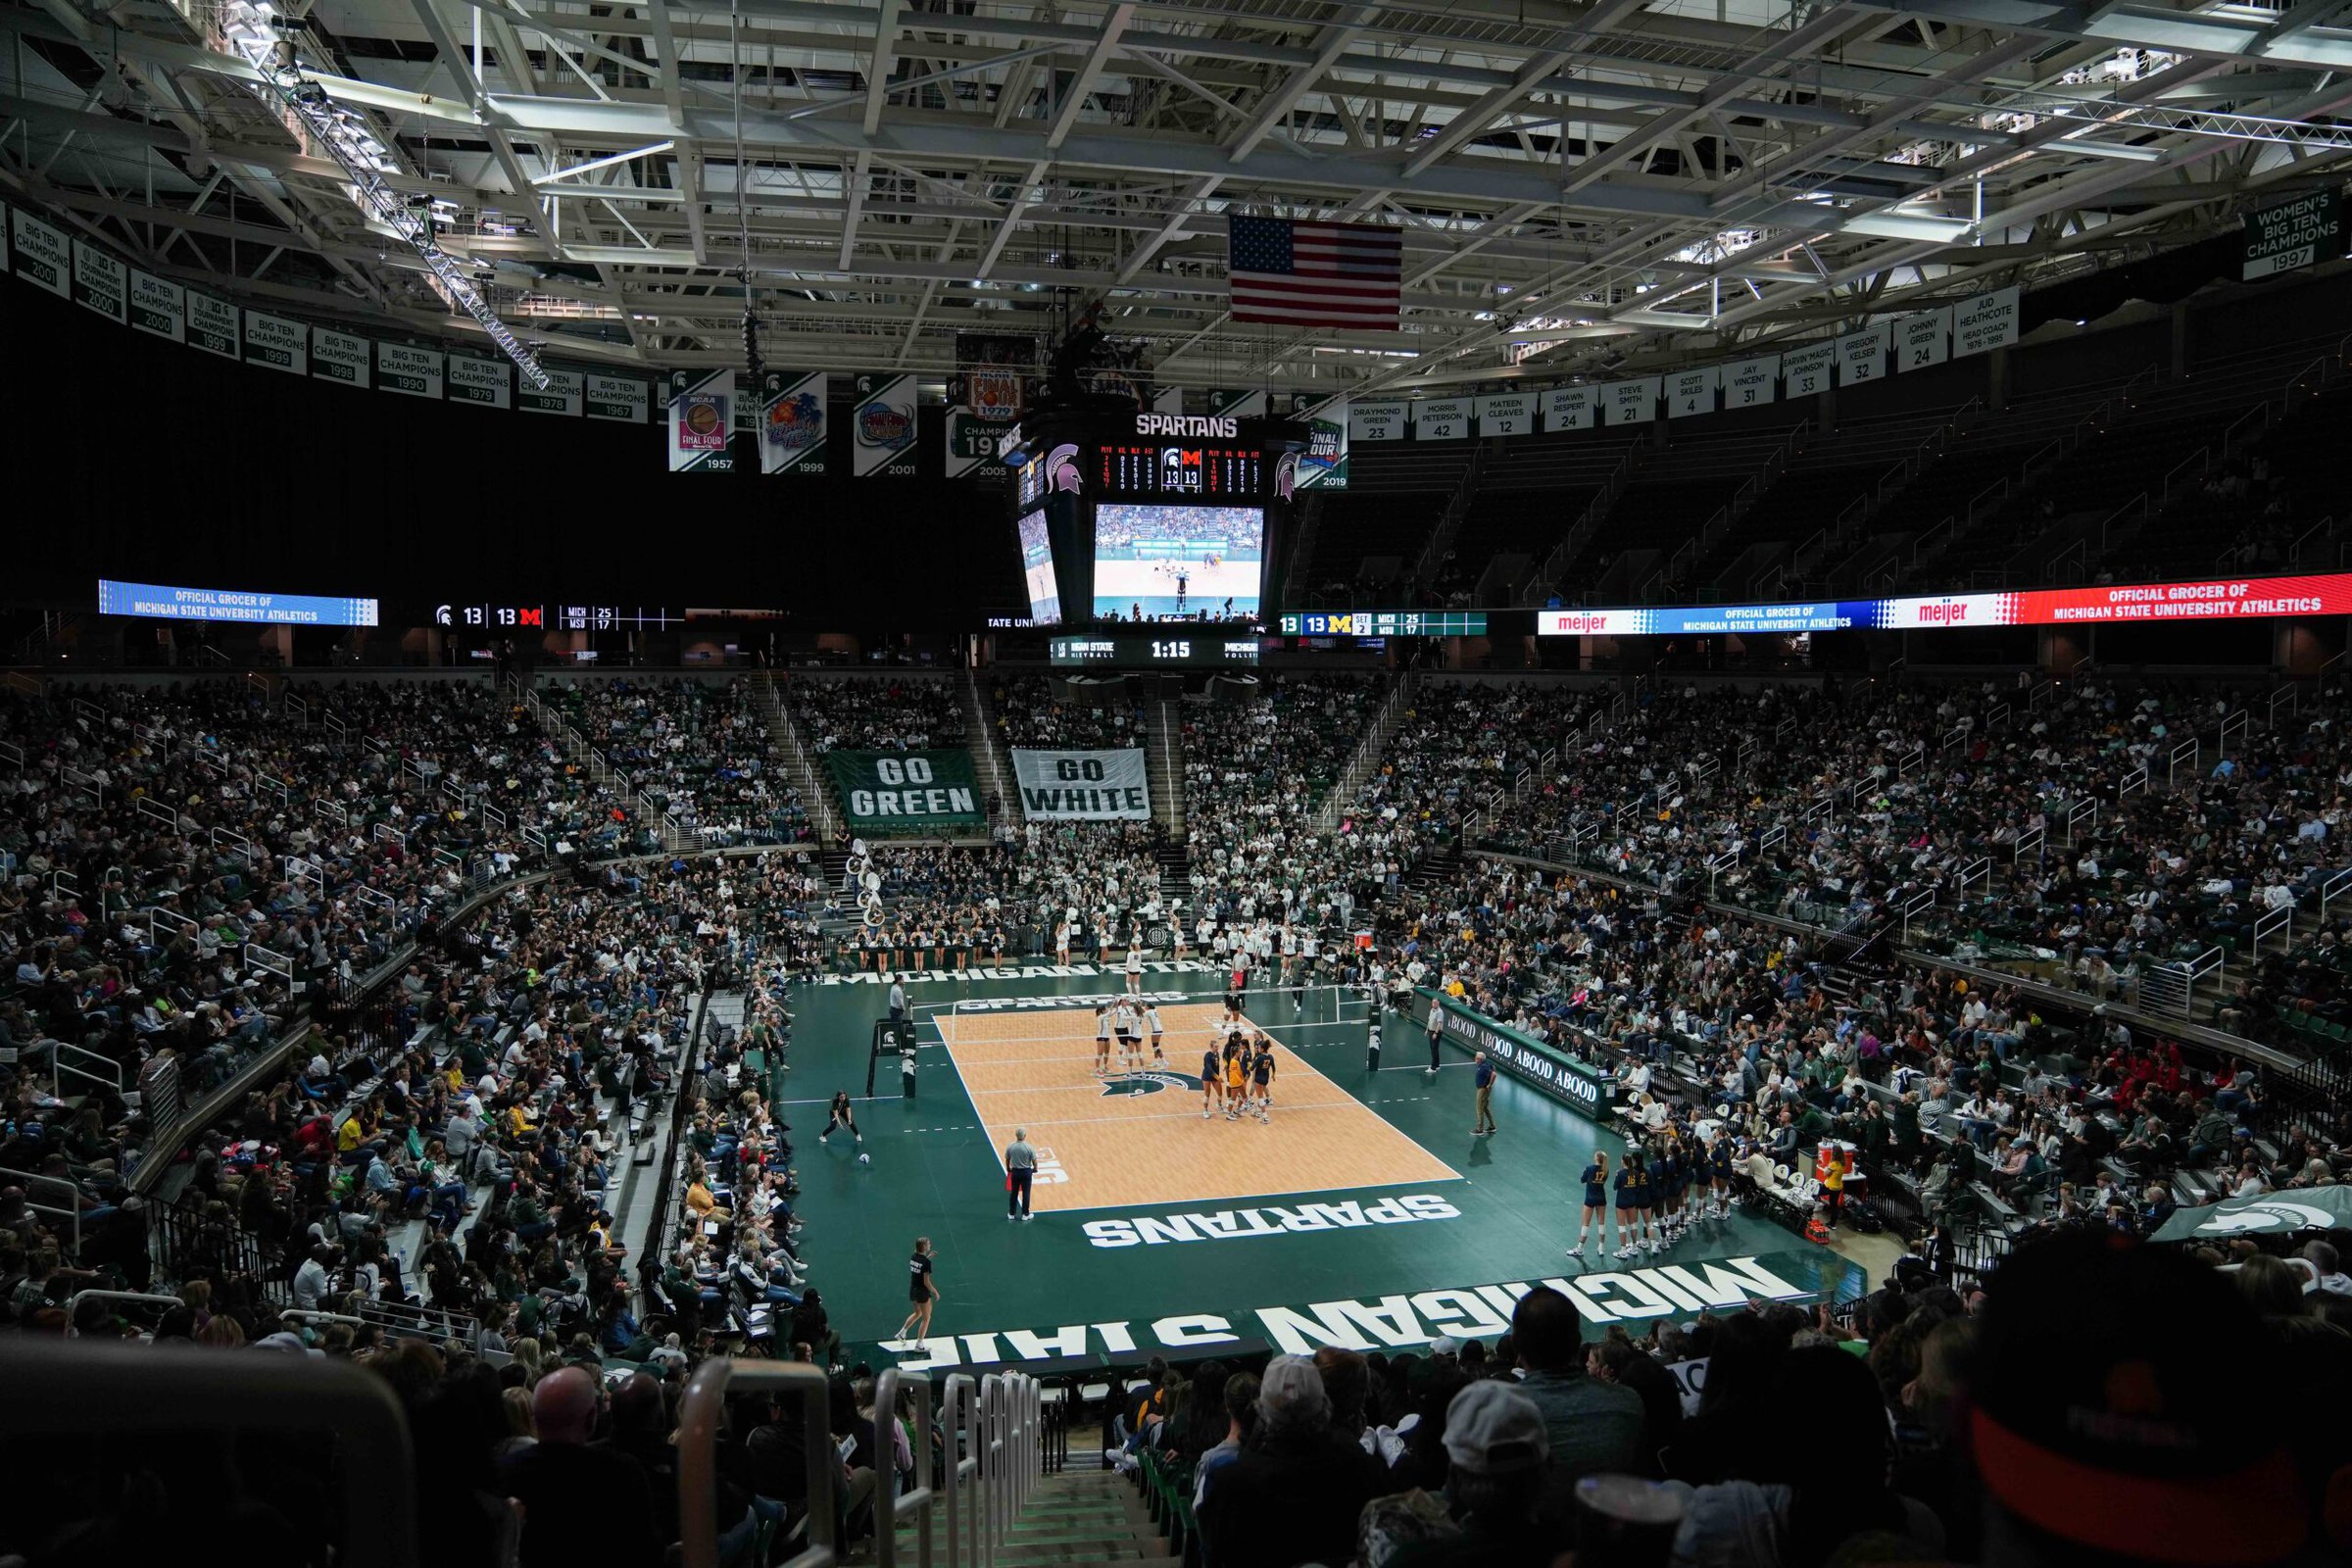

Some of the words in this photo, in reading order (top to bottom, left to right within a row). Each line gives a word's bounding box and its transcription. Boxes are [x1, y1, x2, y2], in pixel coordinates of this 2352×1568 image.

[2257, 193, 2328, 226] WOMEN'S
[2264, 221, 2288, 240] BIG
[2292, 212, 2322, 231] TEN
[25, 222, 40, 238] BIG
[41, 230, 59, 249] TEN
[2247, 220, 2338, 258] CHAMPIONS
[16, 233, 69, 269] CHAMPIONS
[2272, 248, 2310, 270] 1997
[32, 262, 56, 284] 2001
[80, 260, 121, 286] TOURNAMENT
[80, 271, 122, 298] CHAMPIONS
[142, 278, 157, 293] BIG
[157, 284, 173, 299] TEN
[88, 290, 114, 314] 2000
[133, 290, 183, 316] CHAMPIONS
[1978, 297, 1994, 311] JUD
[145, 313, 171, 331] 2000
[194, 308, 234, 326] TOURNAMENT
[1960, 305, 2012, 327] HEATHCOTE
[194, 318, 235, 337] CHAMPIONS
[259, 319, 274, 331] BIG
[276, 323, 294, 337] TEN
[1907, 318, 1938, 334] JOHNNY
[1962, 329, 1983, 341] HEAD
[1983, 321, 2009, 337] COACH
[204, 333, 225, 352] 1999
[247, 329, 306, 351] CHAMPIONS
[324, 335, 339, 347] BIG
[341, 339, 358, 351] TEN
[1845, 334, 1880, 351] GREGORY
[1910, 331, 1936, 346] GREEN
[1987, 333, 2004, 345] 1995
[266, 349, 290, 364] 1999
[314, 345, 368, 365] CHAMPIONS
[392, 349, 408, 361] BIG
[411, 353, 429, 364] TEN
[1849, 347, 1876, 362] KELSER
[1914, 347, 1931, 365] 24
[330, 364, 354, 379] 1998
[380, 360, 441, 376] CHAMPIONS
[463, 361, 478, 372] BIG
[480, 365, 498, 374] TEN
[1742, 366, 1758, 375] JAY
[1793, 362, 1825, 376] JOHNSON
[1855, 364, 1869, 379] 32
[397, 376, 424, 391] 1990
[451, 370, 509, 387] CHAMPIONS
[552, 374, 569, 384] TEN
[600, 380, 615, 390] BIG
[618, 382, 635, 392] TEN
[974, 378, 1017, 392] FINAL
[1680, 375, 1703, 386] SCOTT
[1735, 374, 1766, 386] VINCENT
[1801, 376, 1815, 392] 33
[468, 387, 493, 400] 1979
[589, 390, 647, 404] CHAMPIONS
[1555, 393, 1584, 402] SHAWN
[1618, 385, 1642, 395] STEVE
[1680, 385, 1703, 396] SKILES
[1744, 390, 1755, 403] 31
[539, 396, 564, 410] 1978
[1490, 399, 1522, 409] MATEEN
[1619, 394, 1642, 405] SMITH
[1688, 400, 1695, 412] 4
[606, 405, 630, 416] 1967
[1353, 408, 1400, 416] DRAYMOND
[1488, 408, 1524, 417] CLEAVES
[1553, 402, 1586, 413] RESPERT
[1624, 408, 1637, 420] 21
[1423, 413, 1462, 422] PETERSON
[1561, 416, 1576, 427] 24
[1136, 415, 1239, 439] SPARTANS
[1368, 428, 1385, 439] 23
[1434, 425, 1450, 436] 42
[1499, 421, 1512, 432] 12
[682, 435, 702, 445] FINAL
[704, 435, 722, 445] FOUR
[707, 460, 733, 469] 1957
[1182, 451, 1200, 465] M
[799, 463, 824, 472] 1999
[888, 465, 916, 474] 2001
[980, 466, 1007, 476] 2005
[1166, 471, 1179, 484] 13
[1185, 471, 1198, 484] 13
[175, 590, 217, 606] OFFICIAL
[219, 593, 257, 607] GROCER
[259, 596, 272, 608] OF
[2109, 588, 2166, 602] OFFICIAL
[2168, 585, 2225, 600] GROCER
[2229, 584, 2249, 598] OF
[134, 601, 178, 615] MICHIGAN
[180, 604, 208, 617] STATE
[210, 606, 265, 620] UNIVERSITY
[267, 609, 318, 622] ATHLETICS
[568, 606, 586, 617] MICH
[598, 608, 612, 617] 25
[1725, 608, 1764, 619] OFFICIAL
[1766, 607, 1800, 617] GROCER
[1802, 606, 1814, 616] OF
[1919, 598, 1967, 625] meijer
[2054, 607, 2112, 619] MICHIGAN
[2115, 605, 2152, 617] STATE
[2154, 602, 2236, 617] UNIVERSITY
[2239, 598, 2322, 613] ATHLETICS
[464, 608, 482, 625] 13
[497, 609, 515, 625] 13
[519, 608, 541, 625] M
[569, 619, 585, 629] MSU
[598, 619, 610, 629] 17
[988, 618, 1011, 627] TATE
[1014, 618, 1034, 627] UNI
[1328, 615, 1352, 633] M
[1405, 613, 1419, 623] 25
[1558, 612, 1607, 633] meijer
[1684, 619, 1728, 631] MICHIGAN
[1730, 619, 1756, 629] STATE
[1757, 618, 1807, 629] UNIVERSITY
[1809, 617, 1851, 628] ATHLETICS
[1280, 617, 1298, 632] 13
[1307, 617, 1325, 632] 13
[1379, 625, 1394, 635] MSU
[1405, 625, 1417, 635] 17
[1090, 642, 1114, 652] STATE
[1151, 641, 1190, 659] 1:15
[876, 757, 934, 785] GO
[1056, 758, 1105, 782] GO
[851, 787, 976, 816] GREEN
[1022, 786, 1147, 812] WHITE
[1478, 1030, 1513, 1058] ABOOD
[1515, 1049, 1553, 1079] ABOOD
[1554, 1068, 1597, 1102] ABOOD
[1082, 1193, 1462, 1249] SPARTANS
[877, 1313, 1241, 1372] STATE
